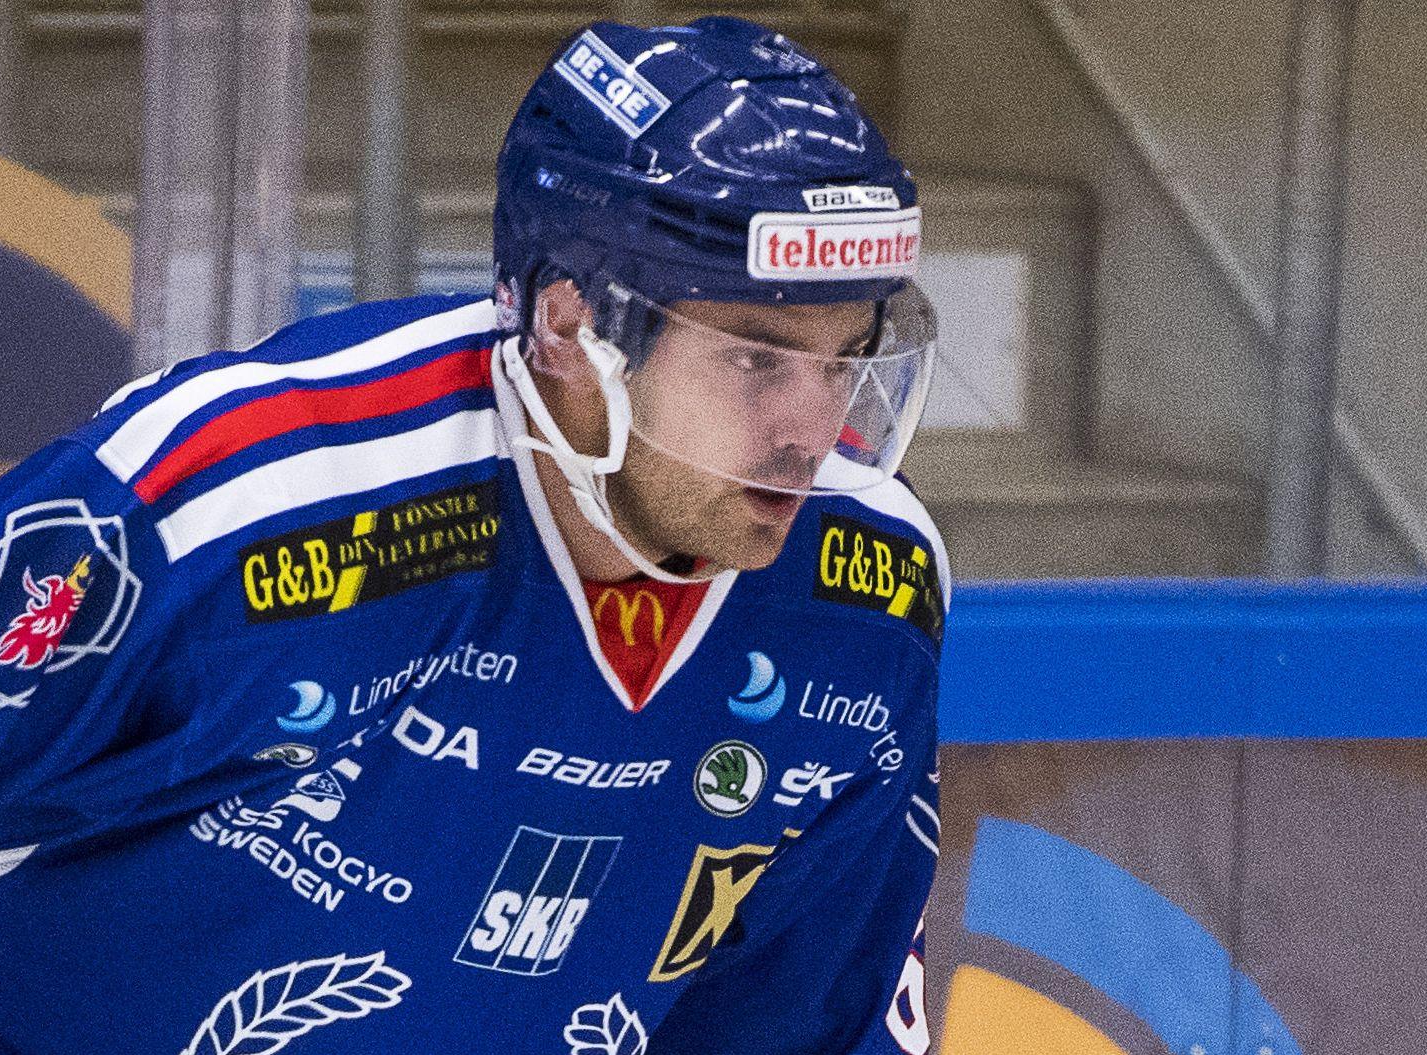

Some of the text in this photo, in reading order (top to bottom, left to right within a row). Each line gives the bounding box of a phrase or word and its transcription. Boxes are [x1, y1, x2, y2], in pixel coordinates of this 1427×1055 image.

[244, 538, 335, 612] G&B
[820, 527, 895, 599] G&B
[516, 747, 672, 789] BAUER
[189, 811, 345, 912] SWEDEN
[292, 821, 413, 904] KOGYO
[471, 889, 590, 961] SKB
